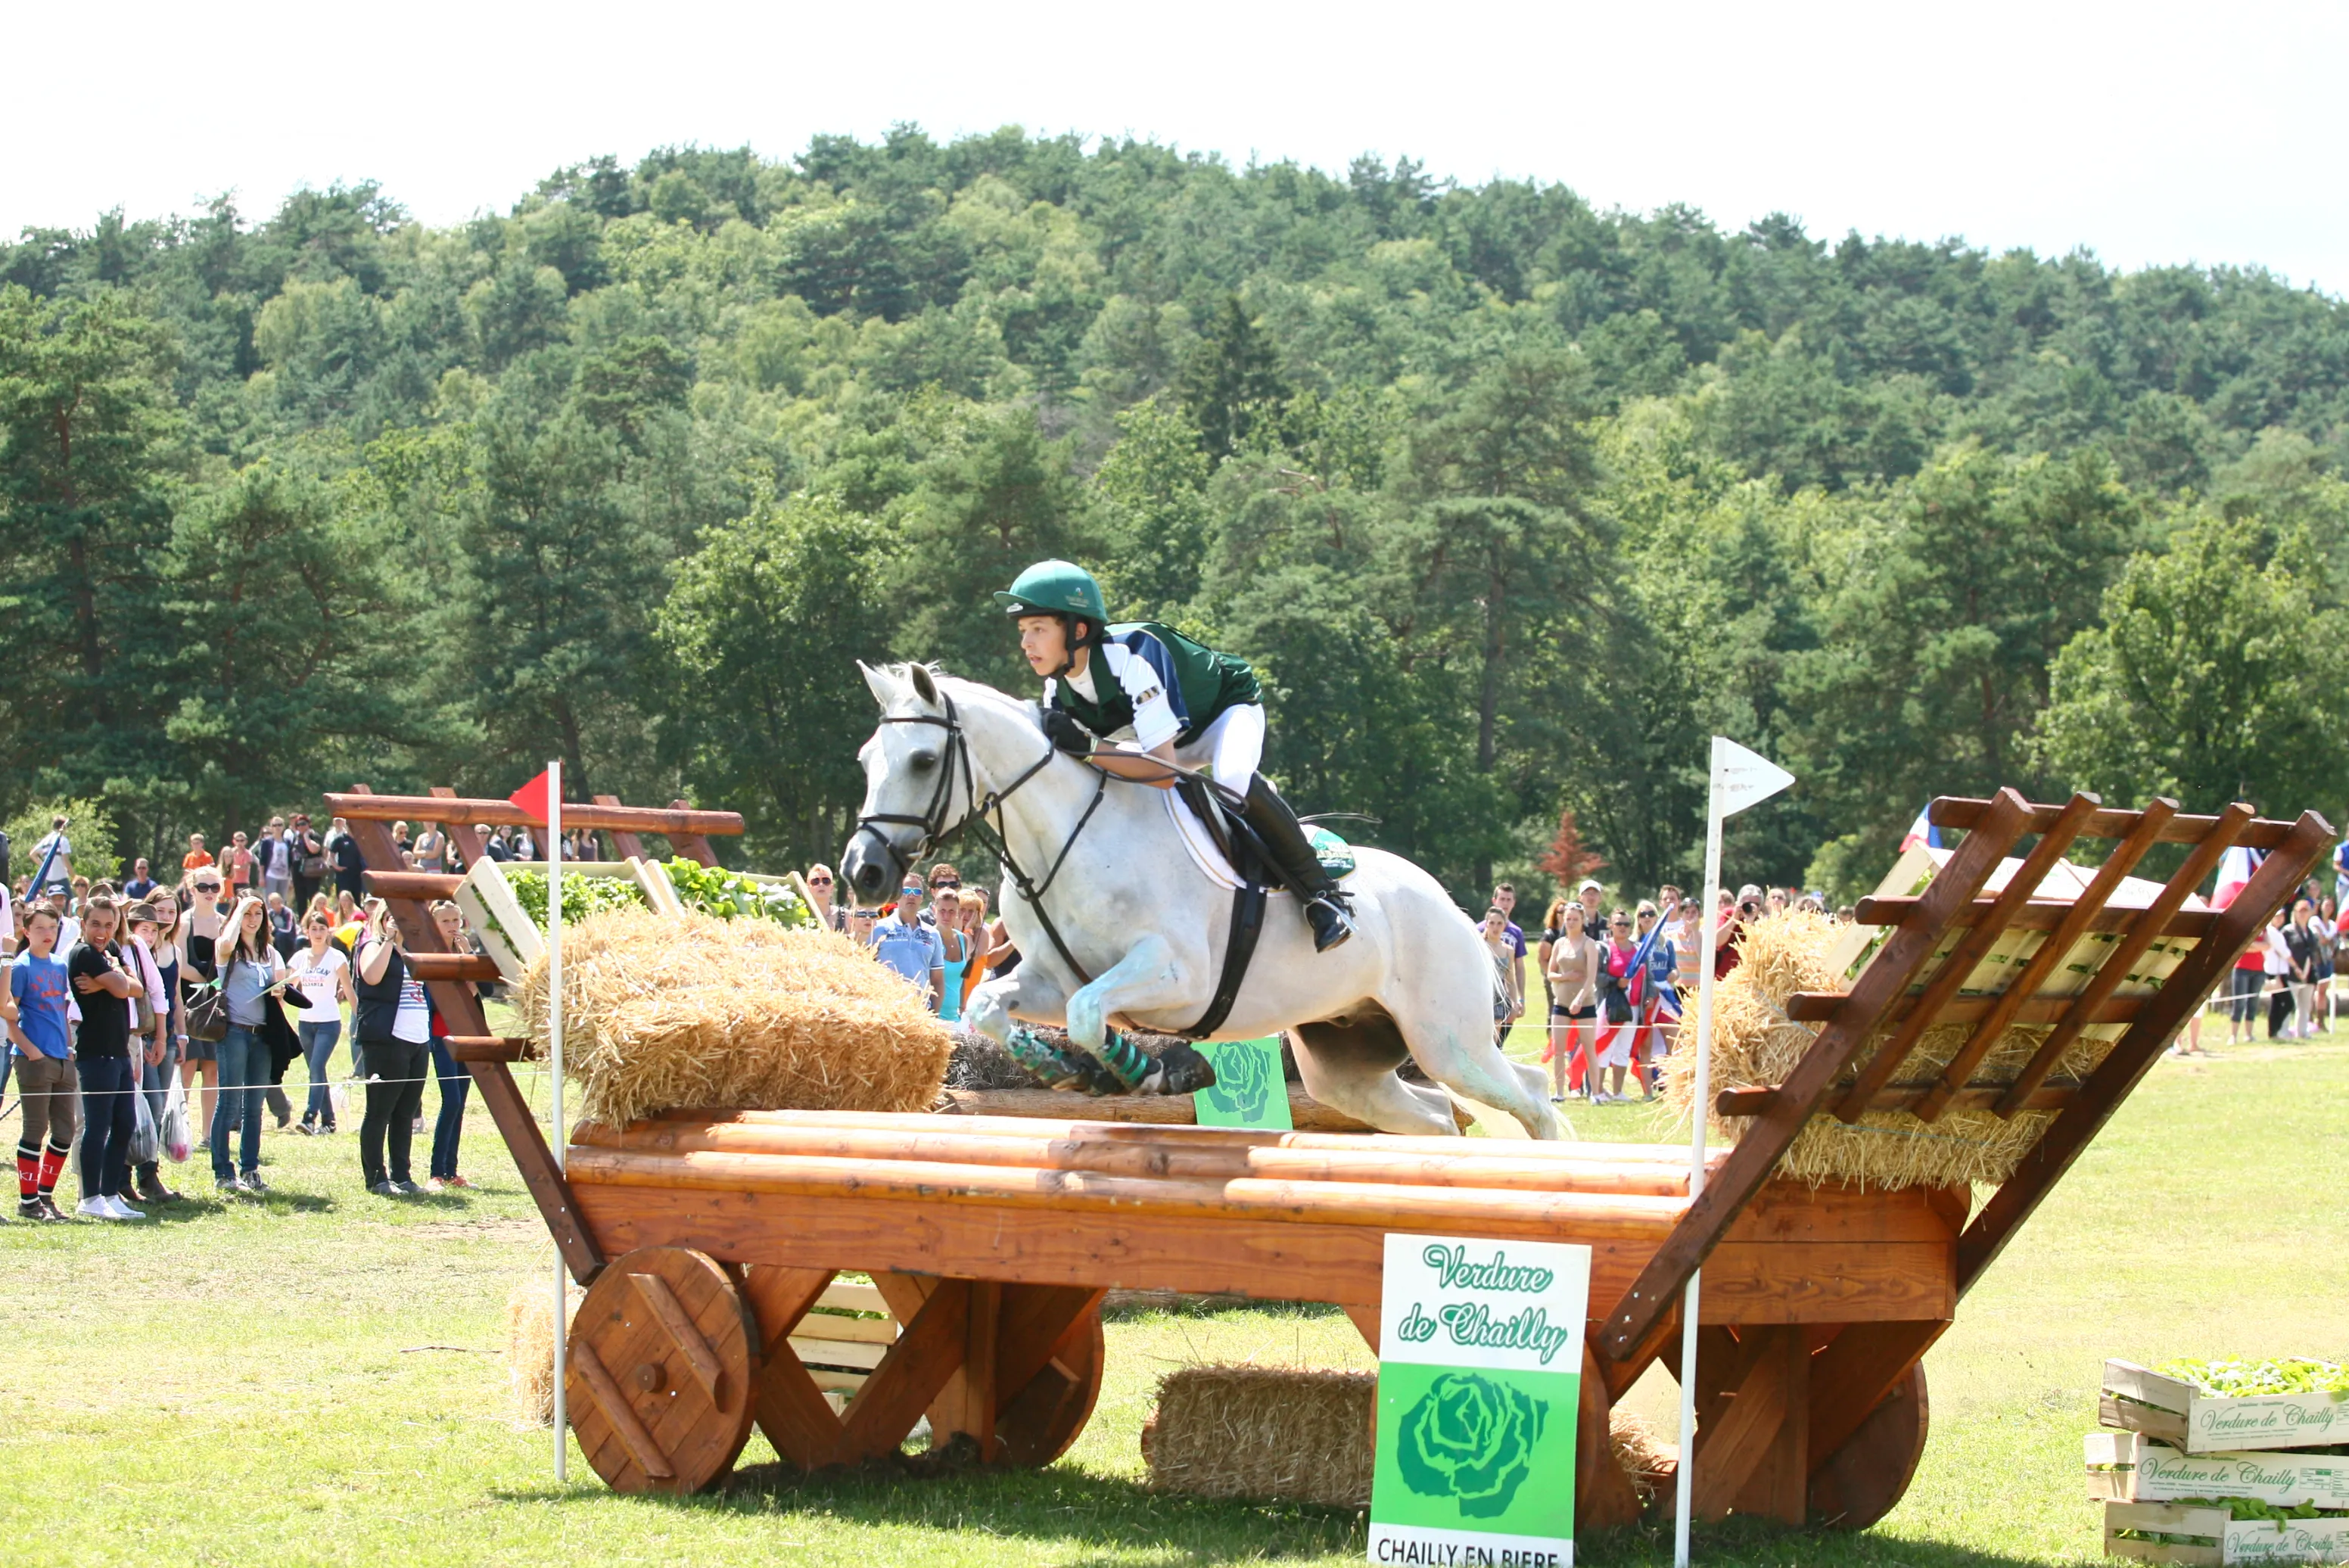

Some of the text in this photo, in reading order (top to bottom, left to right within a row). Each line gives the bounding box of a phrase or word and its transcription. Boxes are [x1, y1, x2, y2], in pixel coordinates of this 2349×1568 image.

[1423, 1244, 1554, 1293] Verdure
[1398, 1302, 1567, 1365] de Chailly
[2200, 1406, 2260, 1431] Verdure
[2260, 1411, 2276, 1426] de
[2283, 1404, 2335, 1433] Chailly
[2140, 1457, 2208, 1481] Verdure
[2211, 1466, 2229, 1482] de
[2236, 1461, 2297, 1494] Chailly
[1377, 1538, 1458, 1567] CHAILLY
[1465, 1545, 1493, 1567] EN
[2226, 1530, 2274, 1554] Verdure
[2276, 1535, 2289, 1552] de
[2294, 1529, 2335, 1557] Chailly
